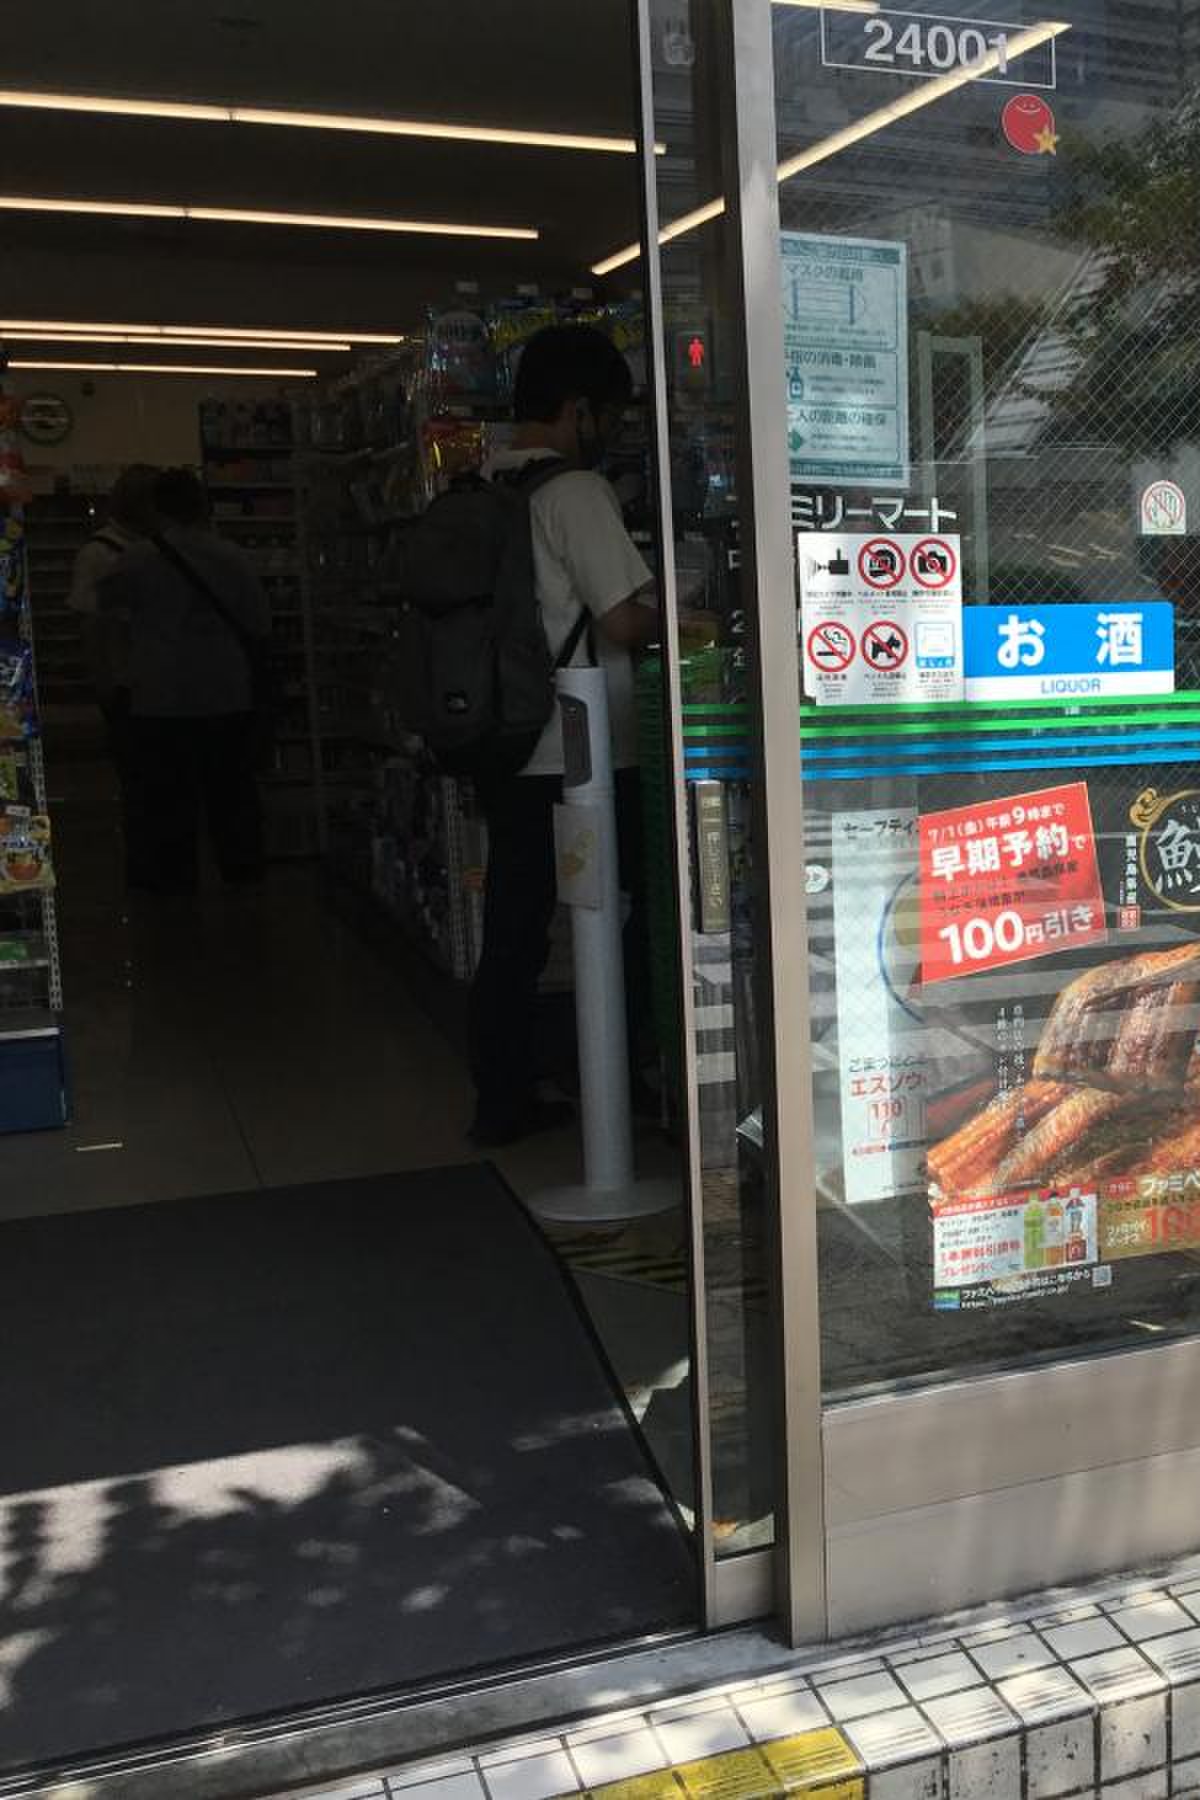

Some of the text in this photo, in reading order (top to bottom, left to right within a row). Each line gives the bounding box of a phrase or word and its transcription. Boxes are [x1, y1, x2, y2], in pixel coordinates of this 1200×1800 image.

[863, 19, 1010, 75] 24001
[791, 496, 957, 533] ミリーマート
[1041, 679, 1102, 694] LIQUOR
[930, 823, 1087, 881] 早期予約で
[938, 904, 1094, 964] 100円引き
